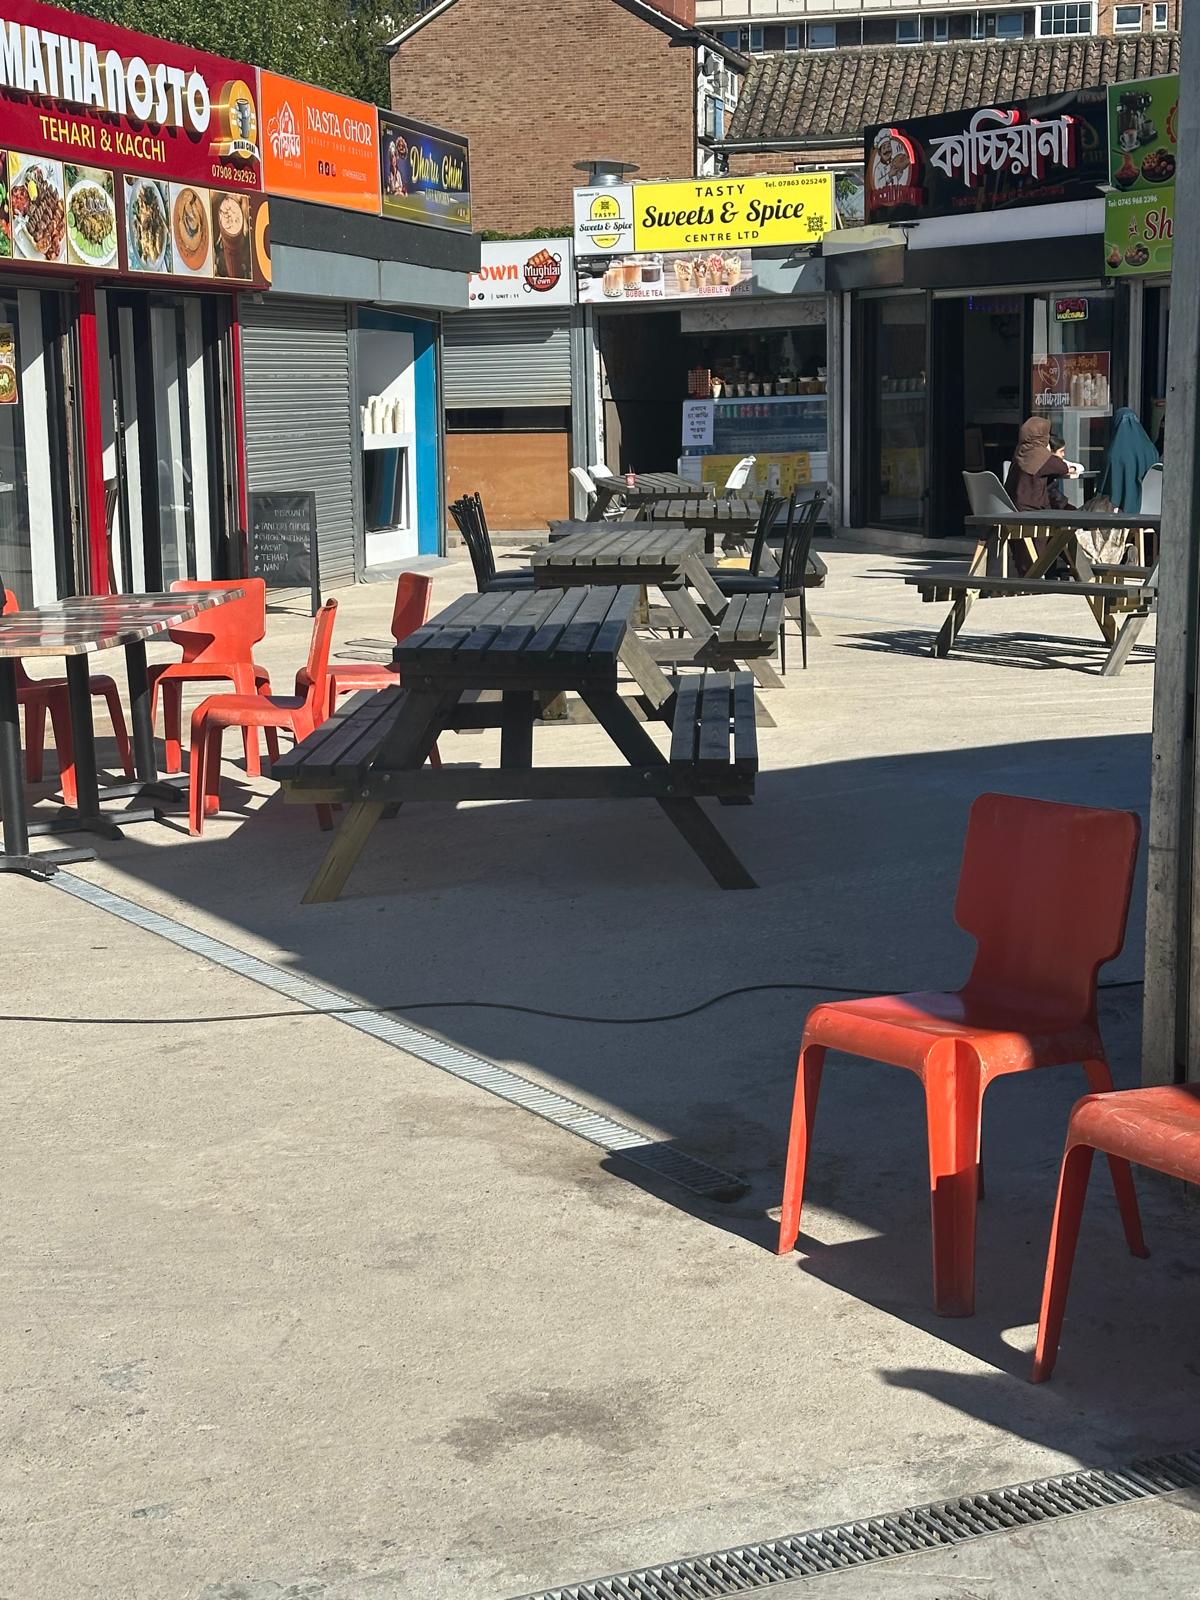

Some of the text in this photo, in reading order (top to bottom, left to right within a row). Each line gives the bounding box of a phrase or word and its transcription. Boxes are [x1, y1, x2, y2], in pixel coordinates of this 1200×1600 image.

[306, 106, 373, 147] NASTA GHOR
[39, 115, 166, 163] TEHARI & KACCHI
[211, 164, 232, 180] 07908
[778, 179, 800, 187] 07863
[800, 177, 827, 186] 025249
[695, 184, 745, 198] TASTY
[642, 199, 805, 228] Sweets & Spice
[579, 221, 633, 232] Sweets & Spice
[685, 230, 759, 243] CENTRE LTD
[467, 263, 519, 283] own
[524, 264, 561, 280] Mughlai
[532, 277, 551, 285] Town
[625, 289, 663, 298] BUBBLE TEA
[699, 284, 750, 294] BUBBLE WAFFLE
[263, 562, 280, 572] NAN
